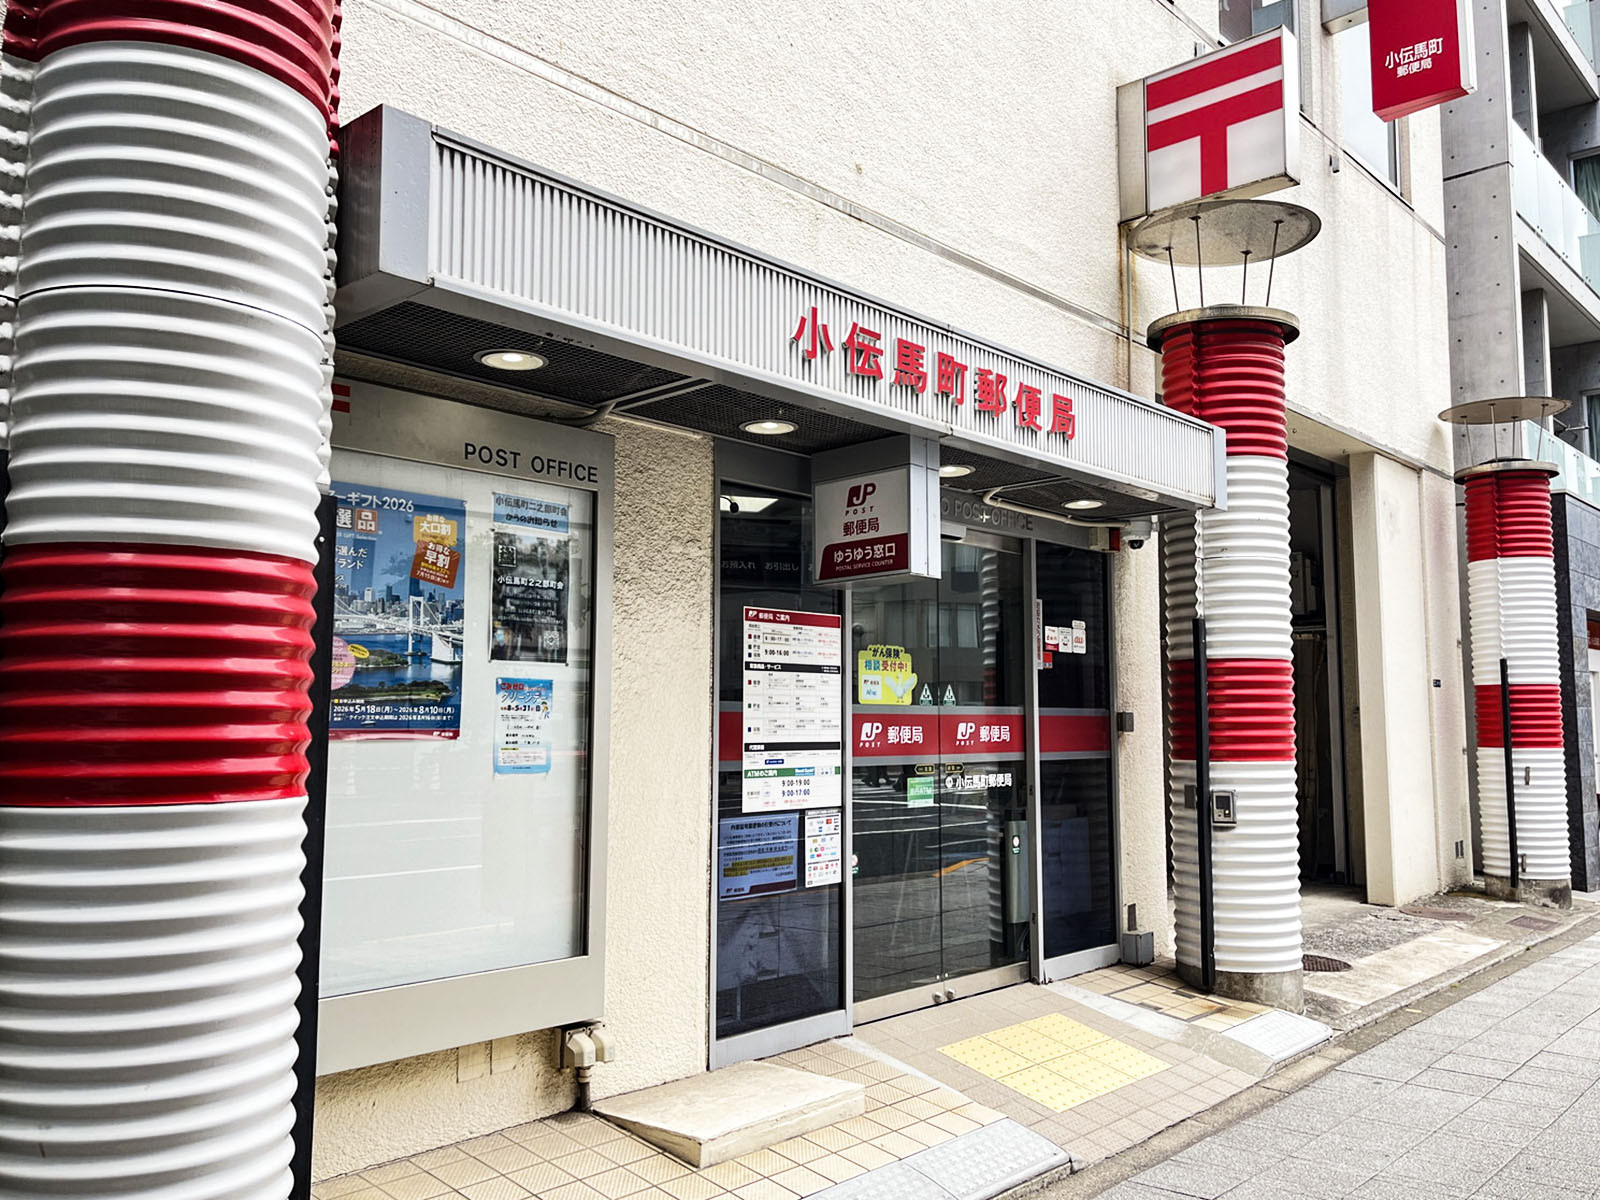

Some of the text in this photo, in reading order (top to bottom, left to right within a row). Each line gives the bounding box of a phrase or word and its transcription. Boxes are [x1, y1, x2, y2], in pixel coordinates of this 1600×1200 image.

[1385, 37, 1443, 69] 小伝馬町
[1396, 57, 1432, 78] 郵便局
[789, 306, 1076, 440] 小伝馬町郵便局
[463, 442, 598, 483] POST OFFICE
[845, 505, 875, 516] POST
[954, 499, 989, 521] POST
[990, 508, 1034, 532] OFFICE
[420, 520, 452, 536] 大口割
[843, 517, 880, 537] 郵便局
[424, 550, 451, 569] 早割
[834, 542, 896, 564] ゆうゆう窓口
[335, 558, 364, 570] ランド
[835, 559, 894, 572] POSTAL SERVICE COUNTER
[887, 726, 923, 744] 郵便局
[979, 725, 1010, 742] 郵便局
[955, 773, 1013, 789] 小伝馬町郵便局
